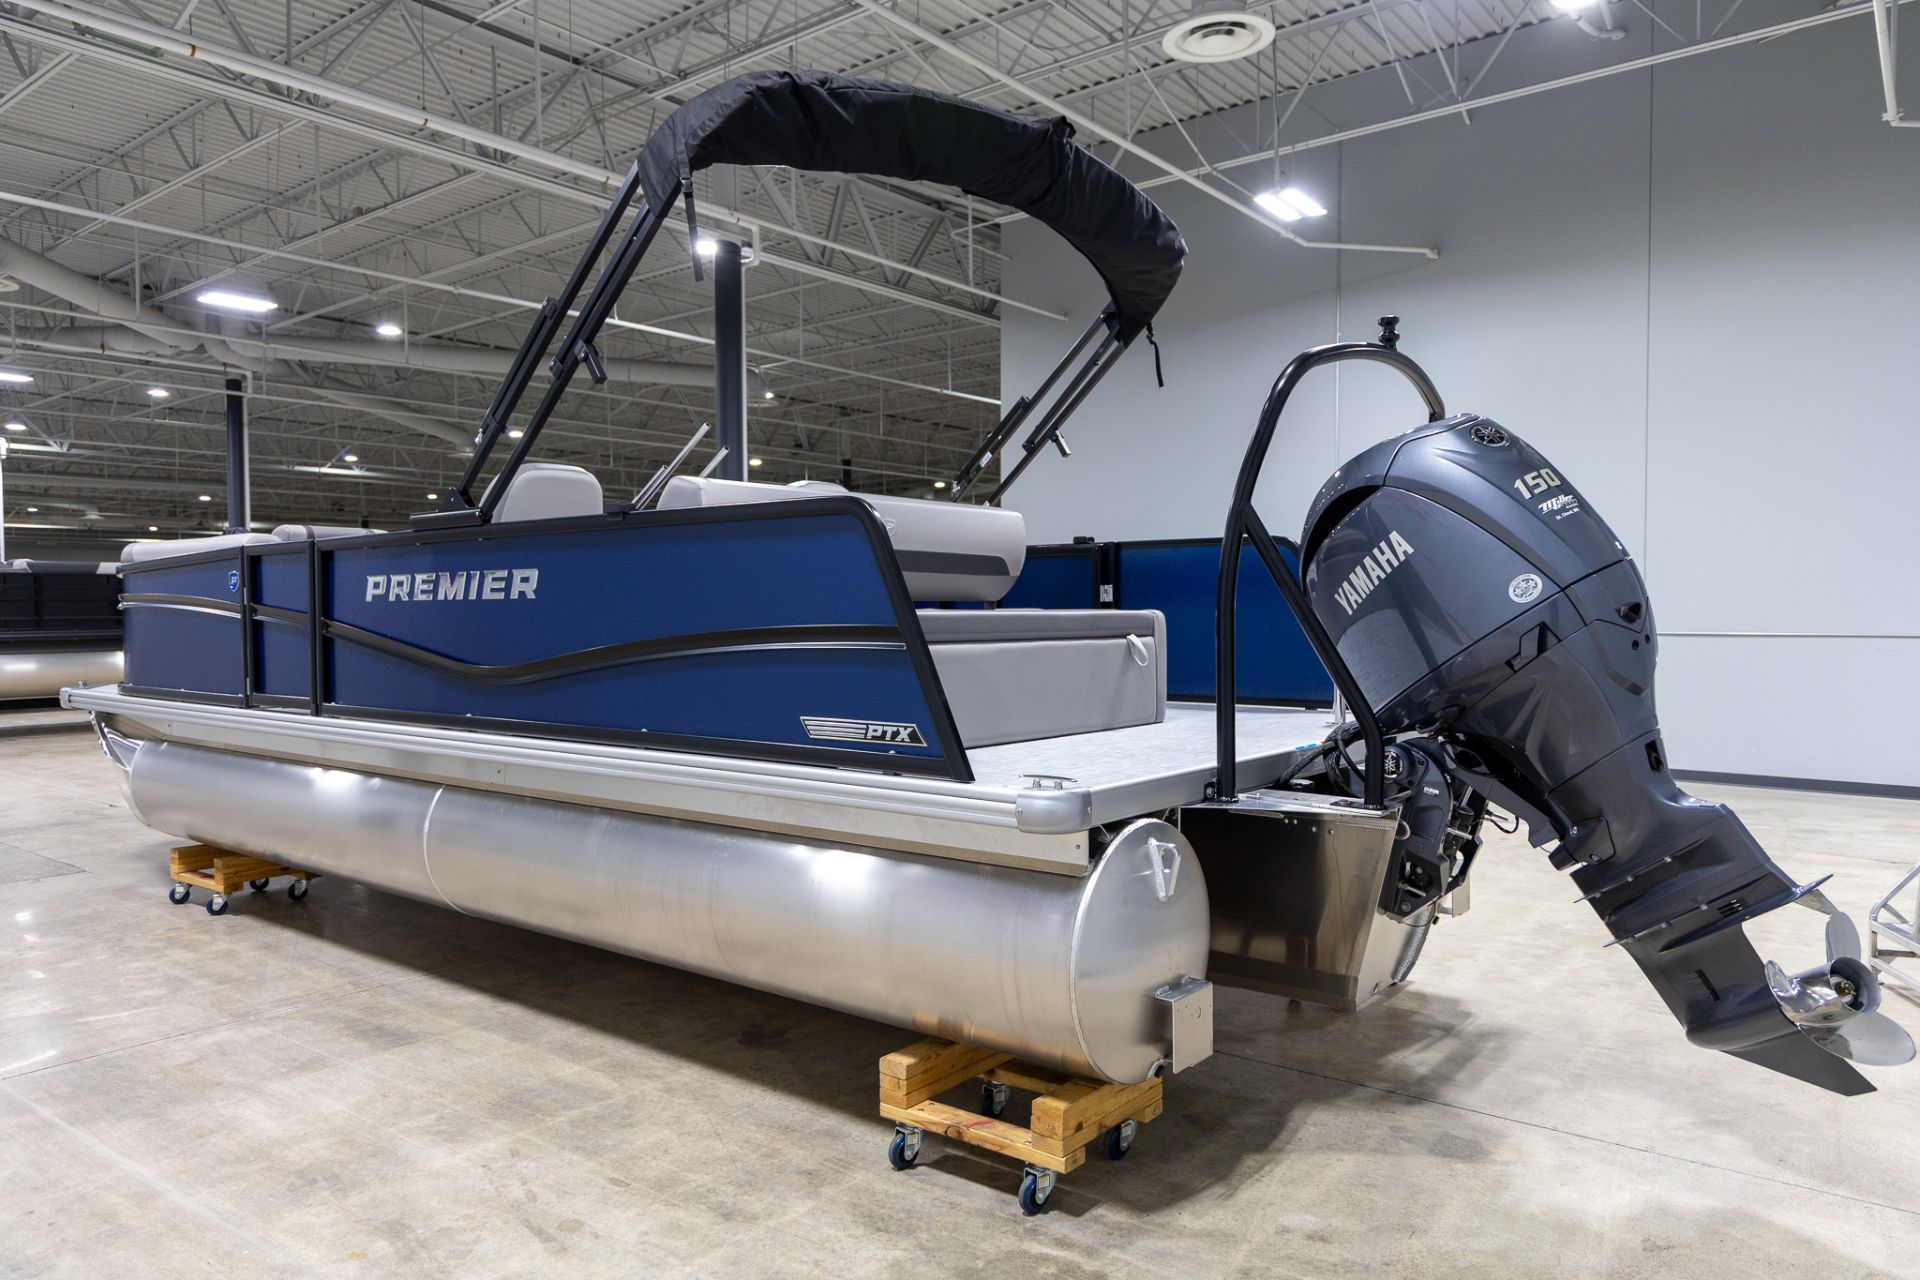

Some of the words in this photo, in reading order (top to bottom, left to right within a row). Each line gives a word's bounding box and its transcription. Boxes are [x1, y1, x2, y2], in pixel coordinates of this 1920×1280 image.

[1514, 468, 1562, 500] 150
[365, 568, 539, 602] PREMIER
[1334, 530, 1415, 616] YAMAHA
[866, 724, 914, 742] PTX
